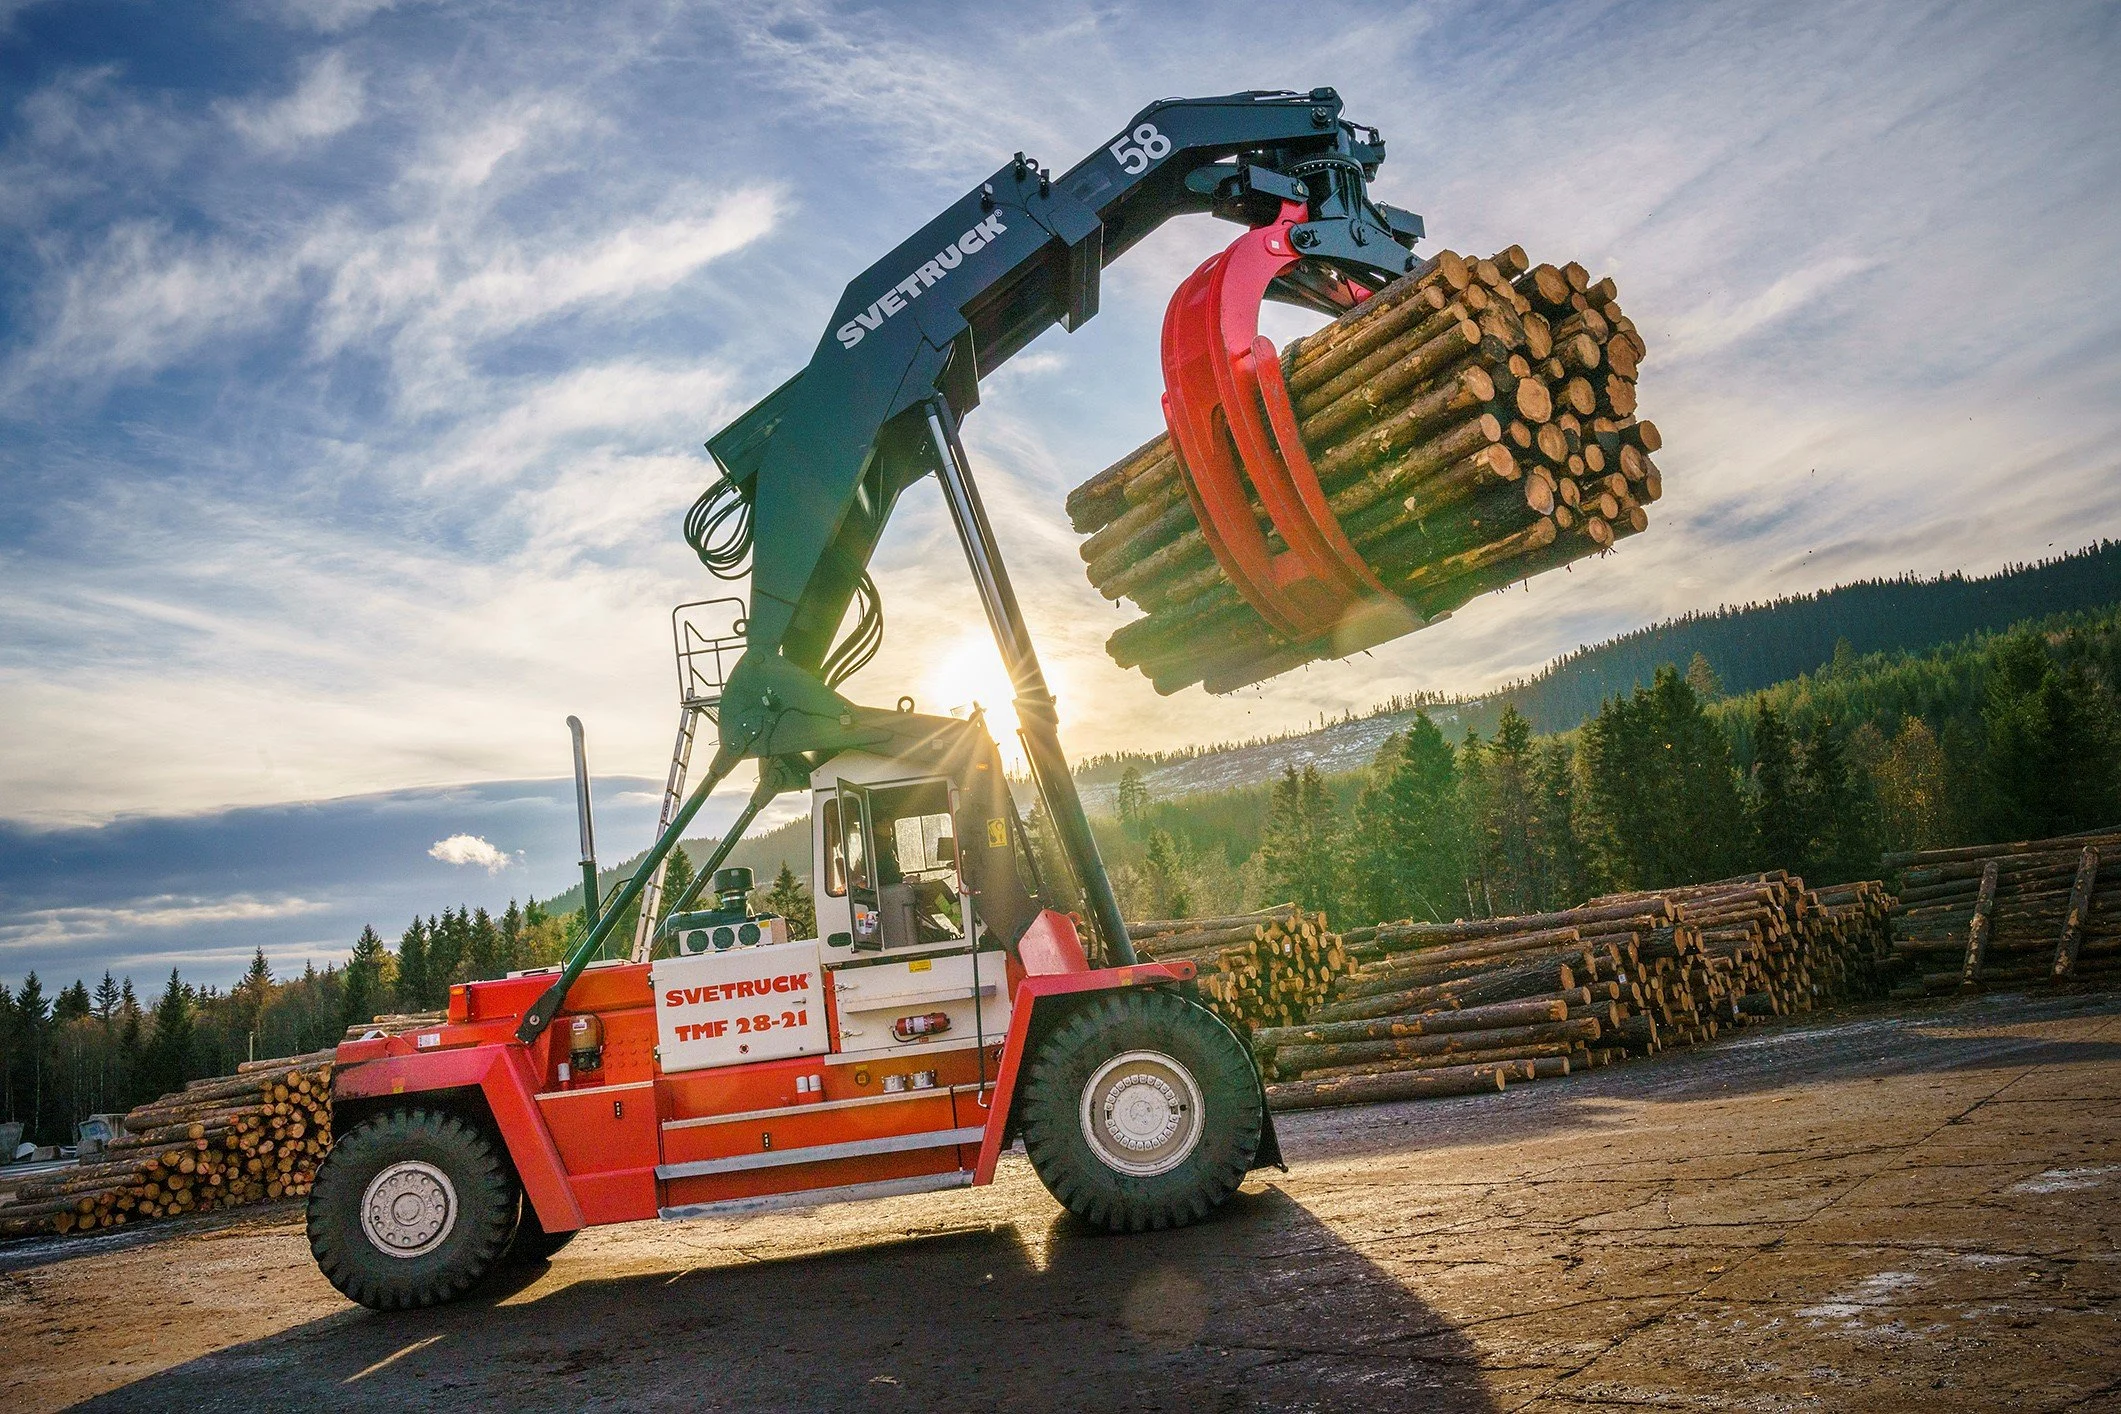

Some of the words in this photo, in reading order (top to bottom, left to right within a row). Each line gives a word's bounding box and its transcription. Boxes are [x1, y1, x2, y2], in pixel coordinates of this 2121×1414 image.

[1108, 123, 1172, 175] 58
[836, 213, 1008, 350] SVETRUCK
[665, 973, 809, 1007] SVETRUCK
[674, 1019, 729, 1043] TMF
[736, 1009, 808, 1035] 28-21
